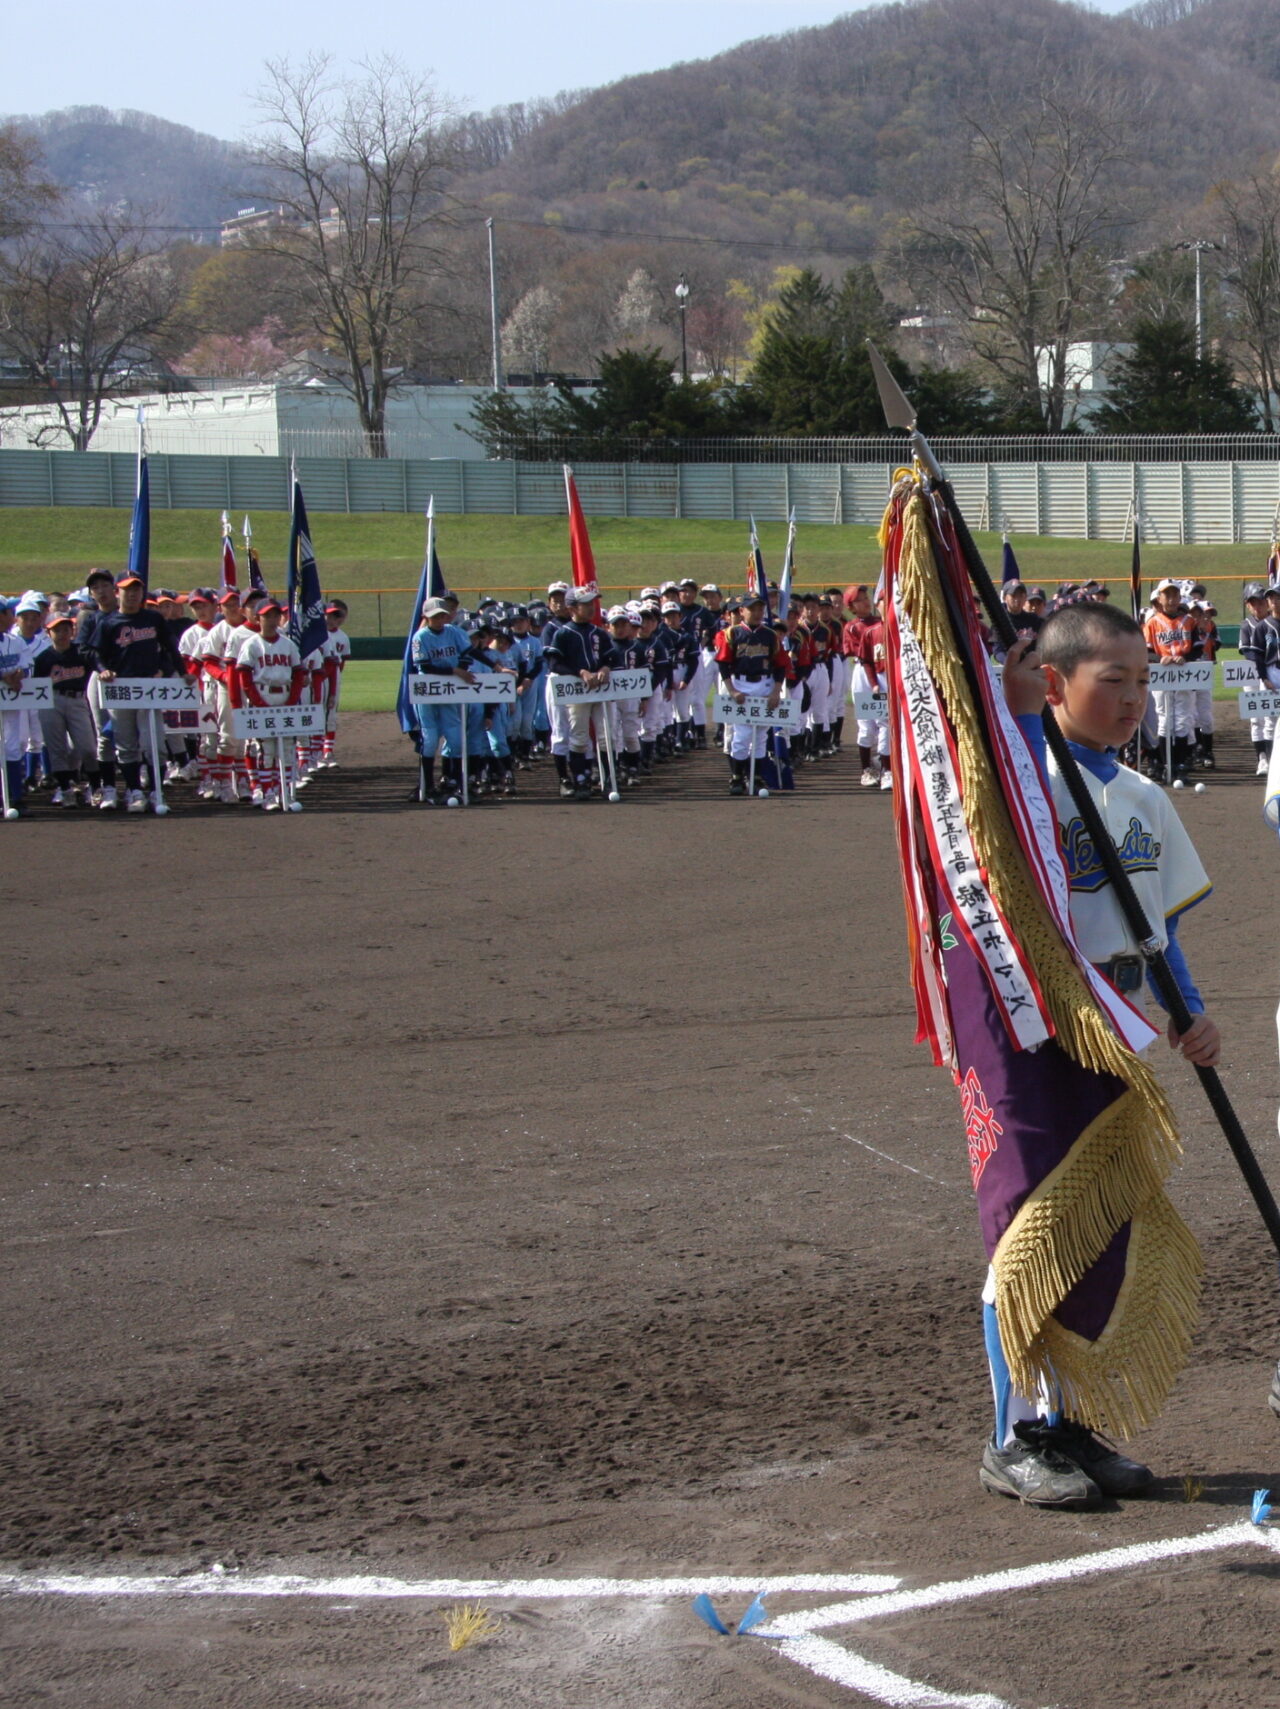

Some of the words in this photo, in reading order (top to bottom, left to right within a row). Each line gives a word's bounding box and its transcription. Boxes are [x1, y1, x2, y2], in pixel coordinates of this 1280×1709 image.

[105, 686, 196, 701] 篠路ライオンズ
[414, 681, 511, 696] 緑丘ホーマーズ
[246, 715, 313, 729] 北区支部
